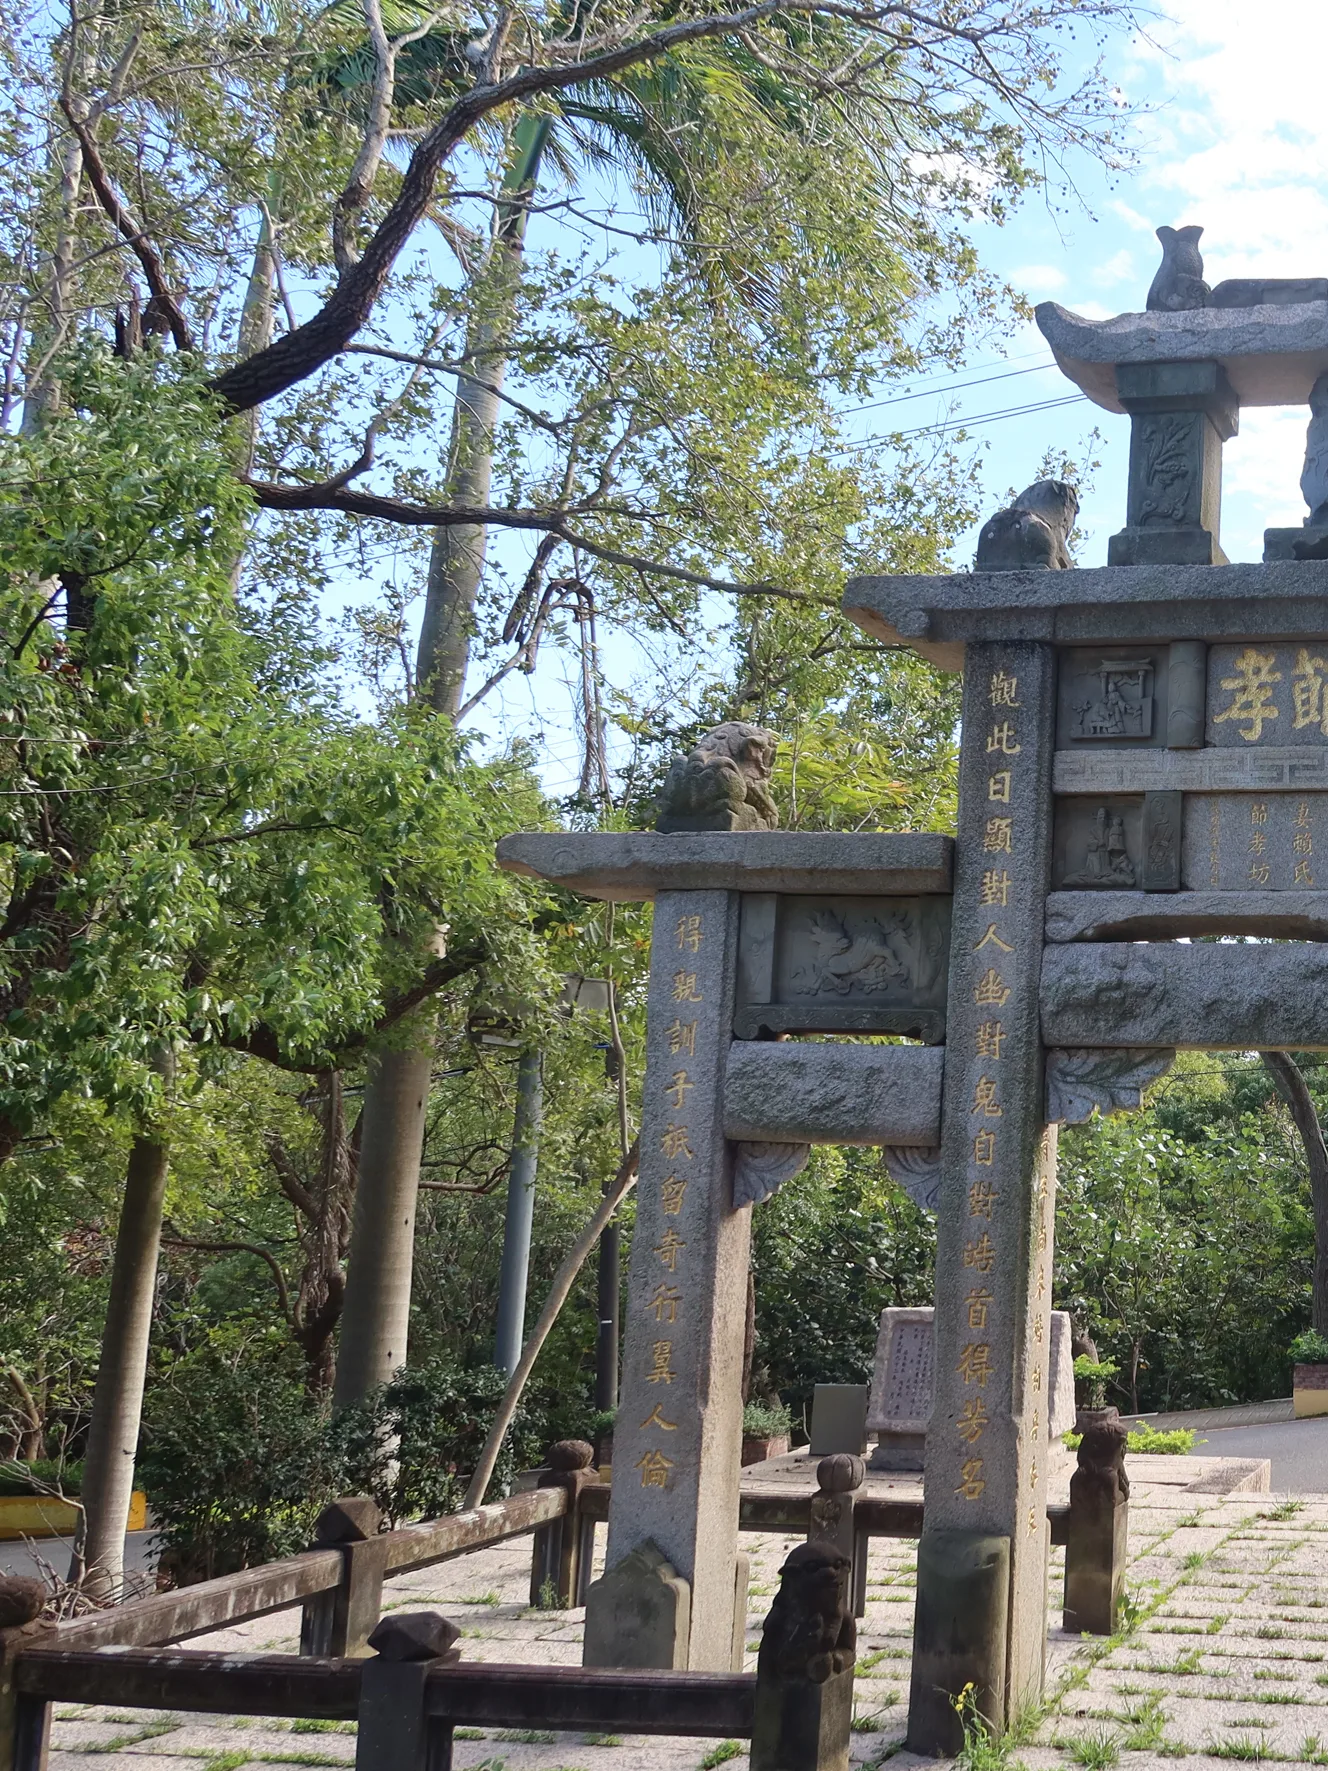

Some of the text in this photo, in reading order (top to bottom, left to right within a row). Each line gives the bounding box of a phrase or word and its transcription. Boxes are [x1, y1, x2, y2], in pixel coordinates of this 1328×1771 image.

[1249, 803, 1270, 884] 節孝坊
[1292, 802, 1315, 885] 妻賴氏
